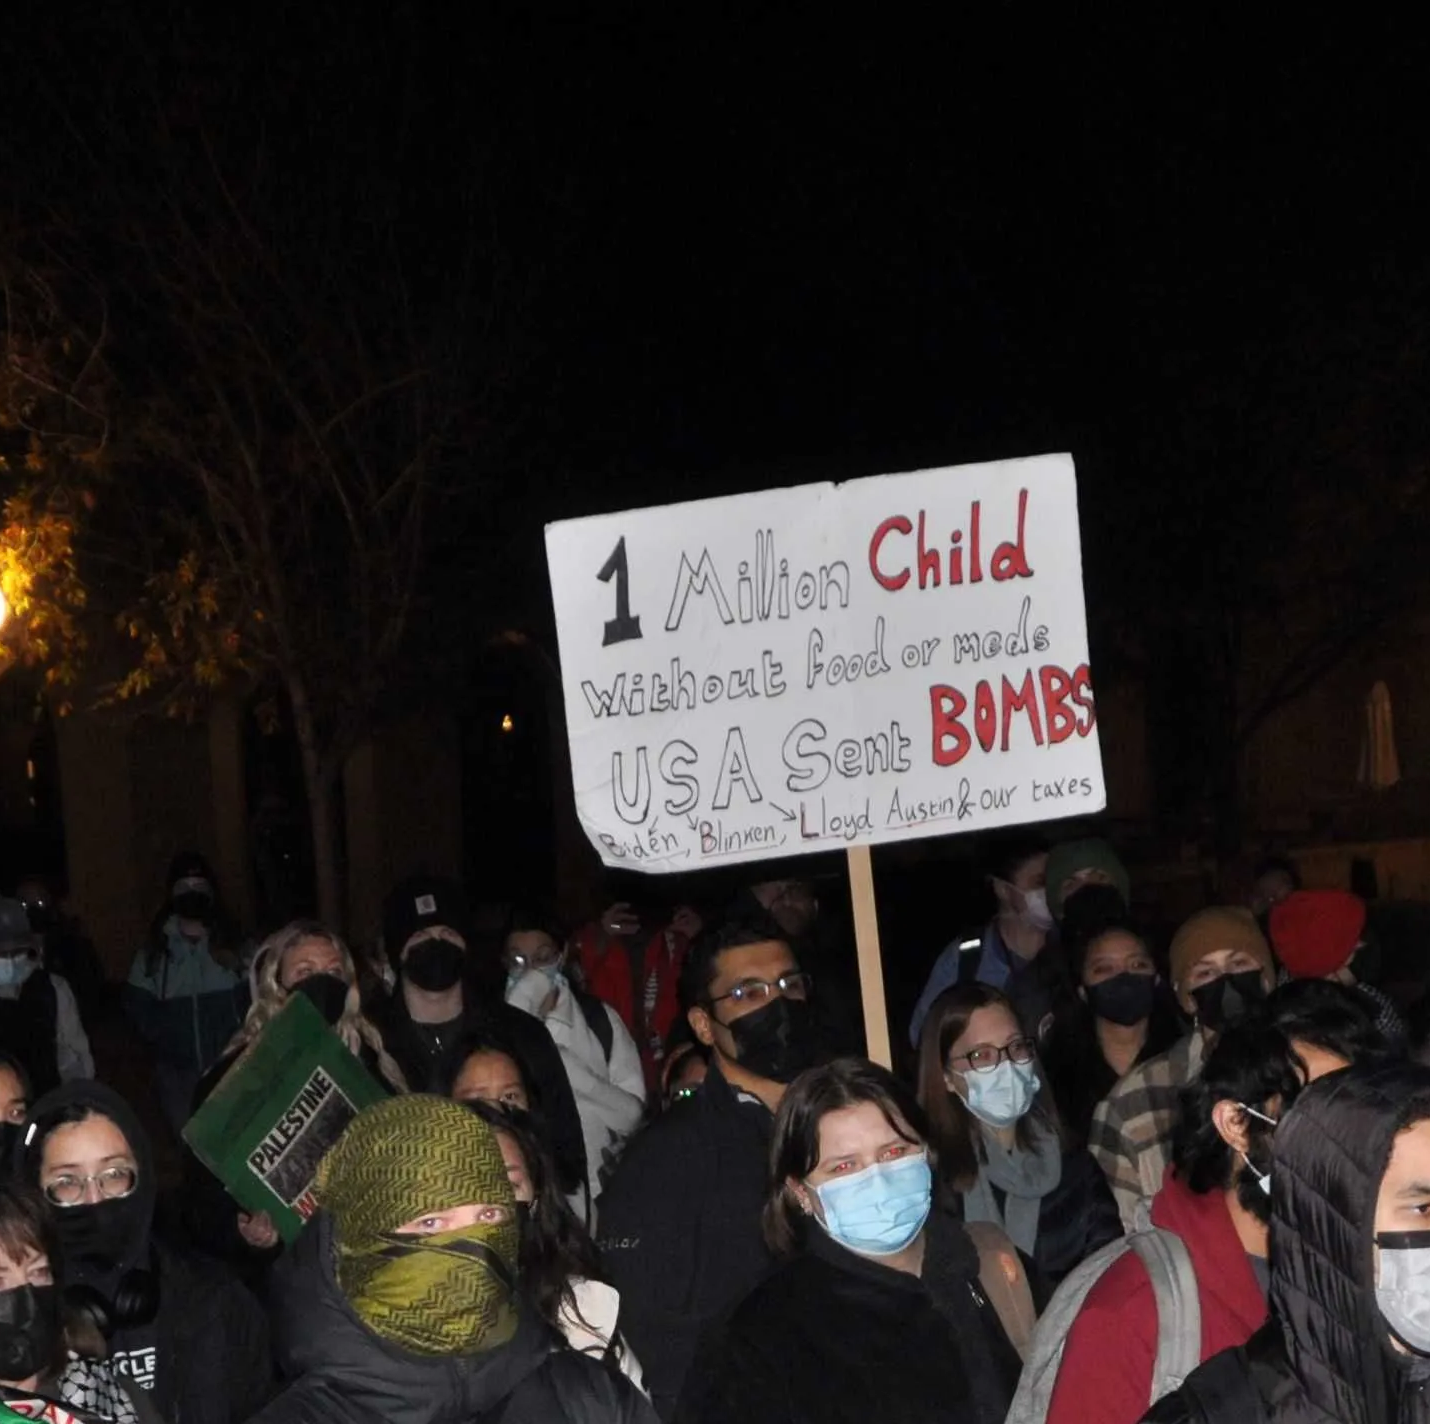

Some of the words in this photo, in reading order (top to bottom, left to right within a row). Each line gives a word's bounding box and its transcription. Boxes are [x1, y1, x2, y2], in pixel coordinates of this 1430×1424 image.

[596, 535, 643, 647] 1
[665, 528, 849, 631] Million
[869, 488, 1034, 592] Child
[807, 615, 891, 688] food
[902, 637, 940, 668] or
[953, 595, 1050, 663] meds
[781, 718, 912, 792] Sent
[929, 663, 1097, 767] BOMBS
[800, 795, 873, 841] Lloyd
[886, 786, 955, 824] Austin
[980, 785, 1018, 810] our
[1032, 777, 1092, 802] taxes
[248, 1069, 333, 1176] PALESTINE
